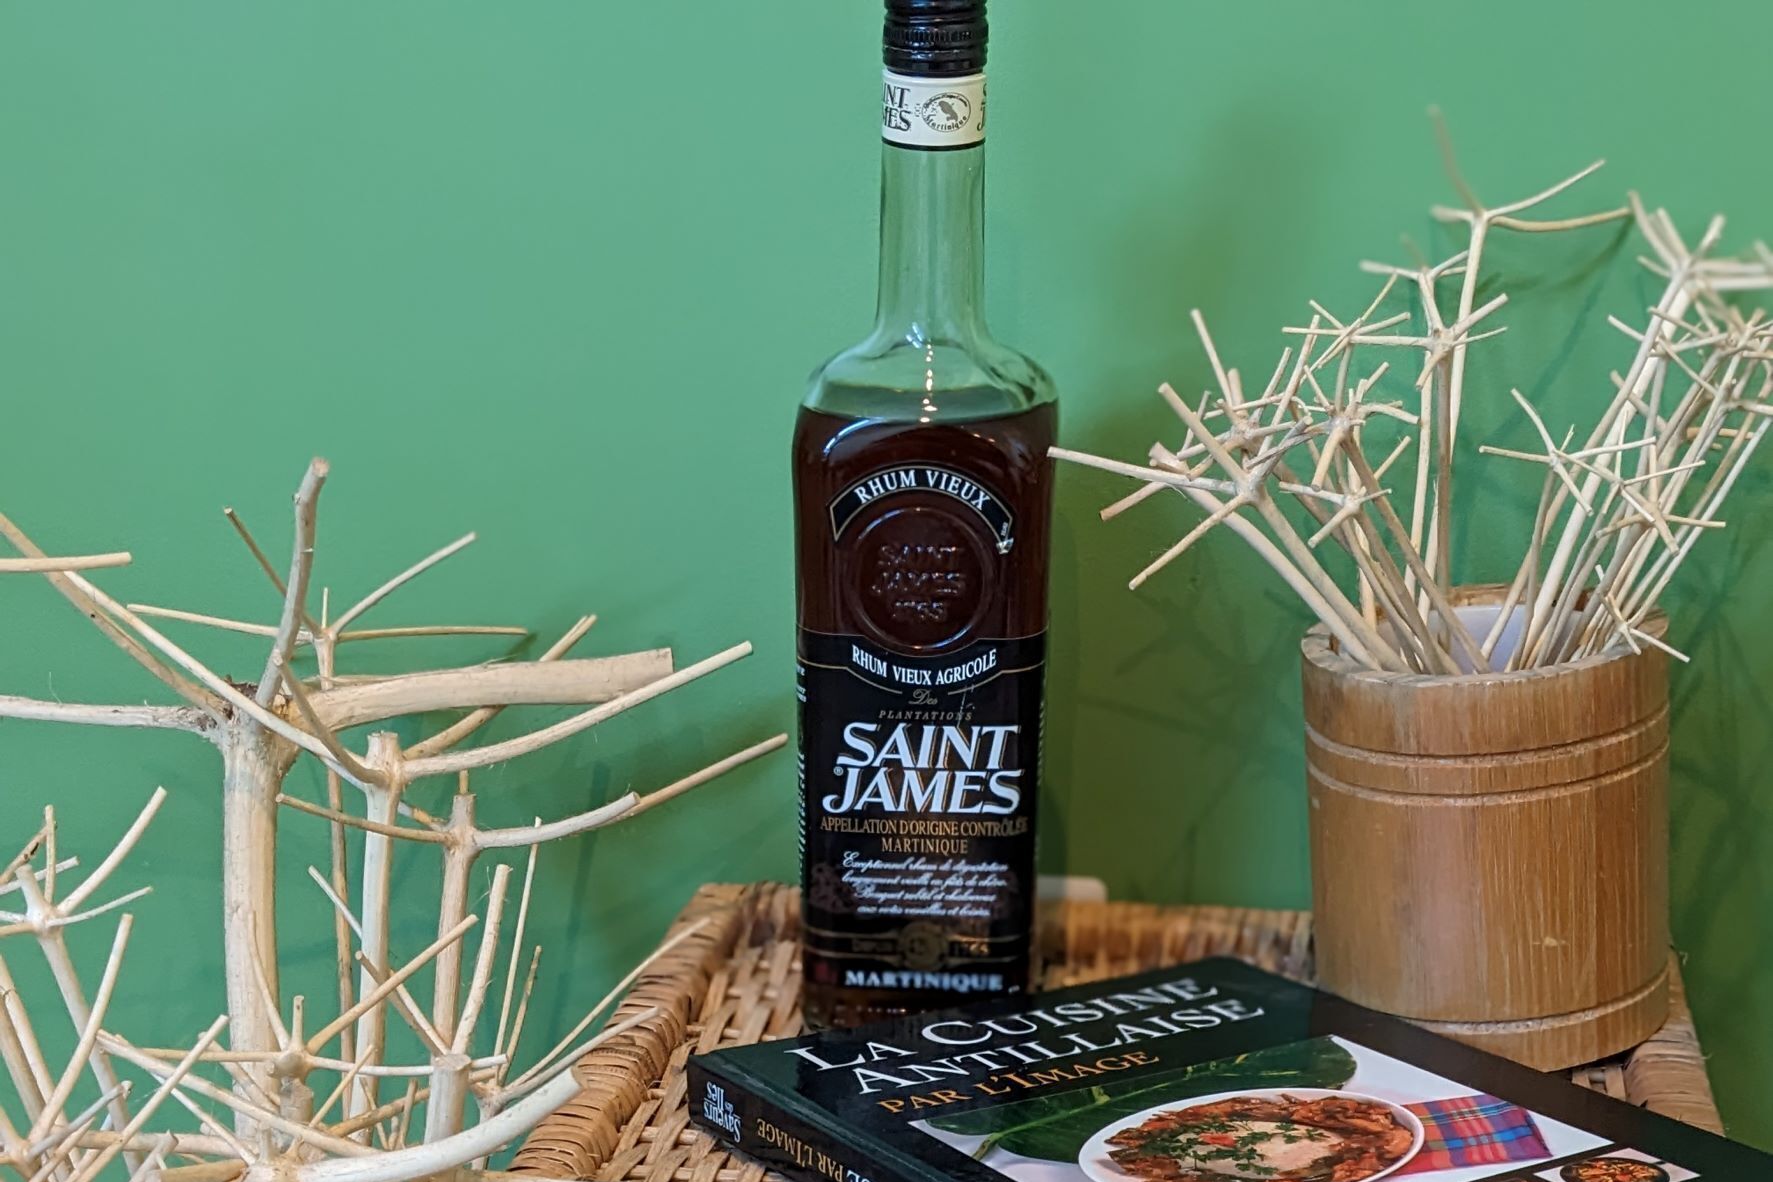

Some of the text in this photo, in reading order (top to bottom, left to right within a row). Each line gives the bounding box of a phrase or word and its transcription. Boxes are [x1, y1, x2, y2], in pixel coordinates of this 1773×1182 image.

[854, 470, 991, 510] RHUM VIEUX
[852, 645, 997, 686] RHUM VIEUX AGRICOLE
[878, 709, 973, 721] PLANTATIONS
[836, 722, 1021, 770] SAINT
[822, 767, 1024, 814] JAMES
[820, 816, 897, 834] APPELLATION
[900, 820, 959, 836] D'ORIGINE
[882, 837, 968, 856] MARTINIQUE
[845, 970, 1003, 992] MARTINIQUE
[784, 977, 1218, 1071] LA CUISINE
[850, 999, 1264, 1095] ANTILLAISE
[876, 1050, 1160, 1114] PAR L'IMAGE
[704, 1103, 742, 1143] Saveurs
[756, 1118, 814, 1168] L'IMAGE
